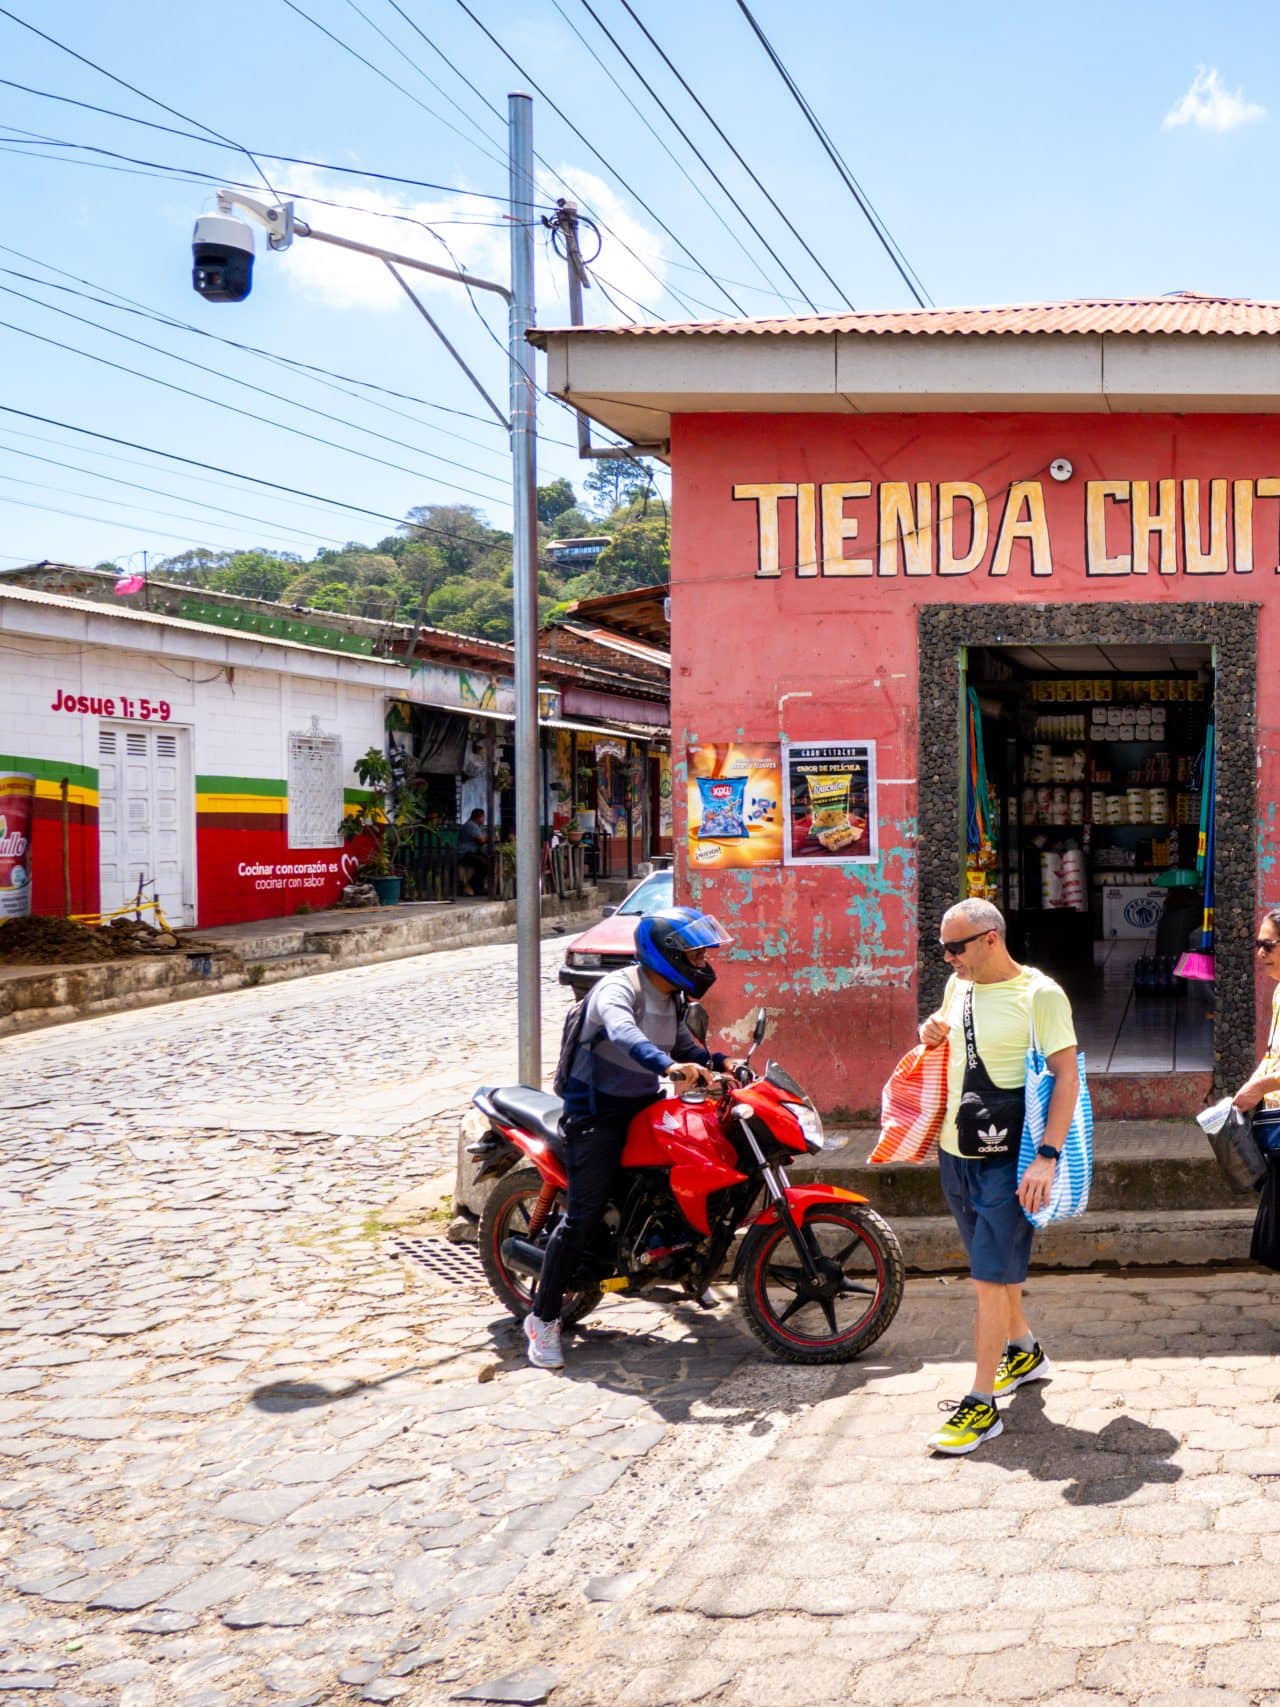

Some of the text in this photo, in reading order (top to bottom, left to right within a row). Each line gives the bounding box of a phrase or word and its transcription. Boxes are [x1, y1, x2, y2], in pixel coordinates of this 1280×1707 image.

[732, 482, 1054, 578] TIENDA
[51, 689, 115, 716] Josue
[139, 698, 171, 721] 5-9
[238, 860, 339, 876] Cocinar con corazón es
[255, 873, 326, 890] cocinar con sabor
[977, 1144, 1009, 1154] adidas
